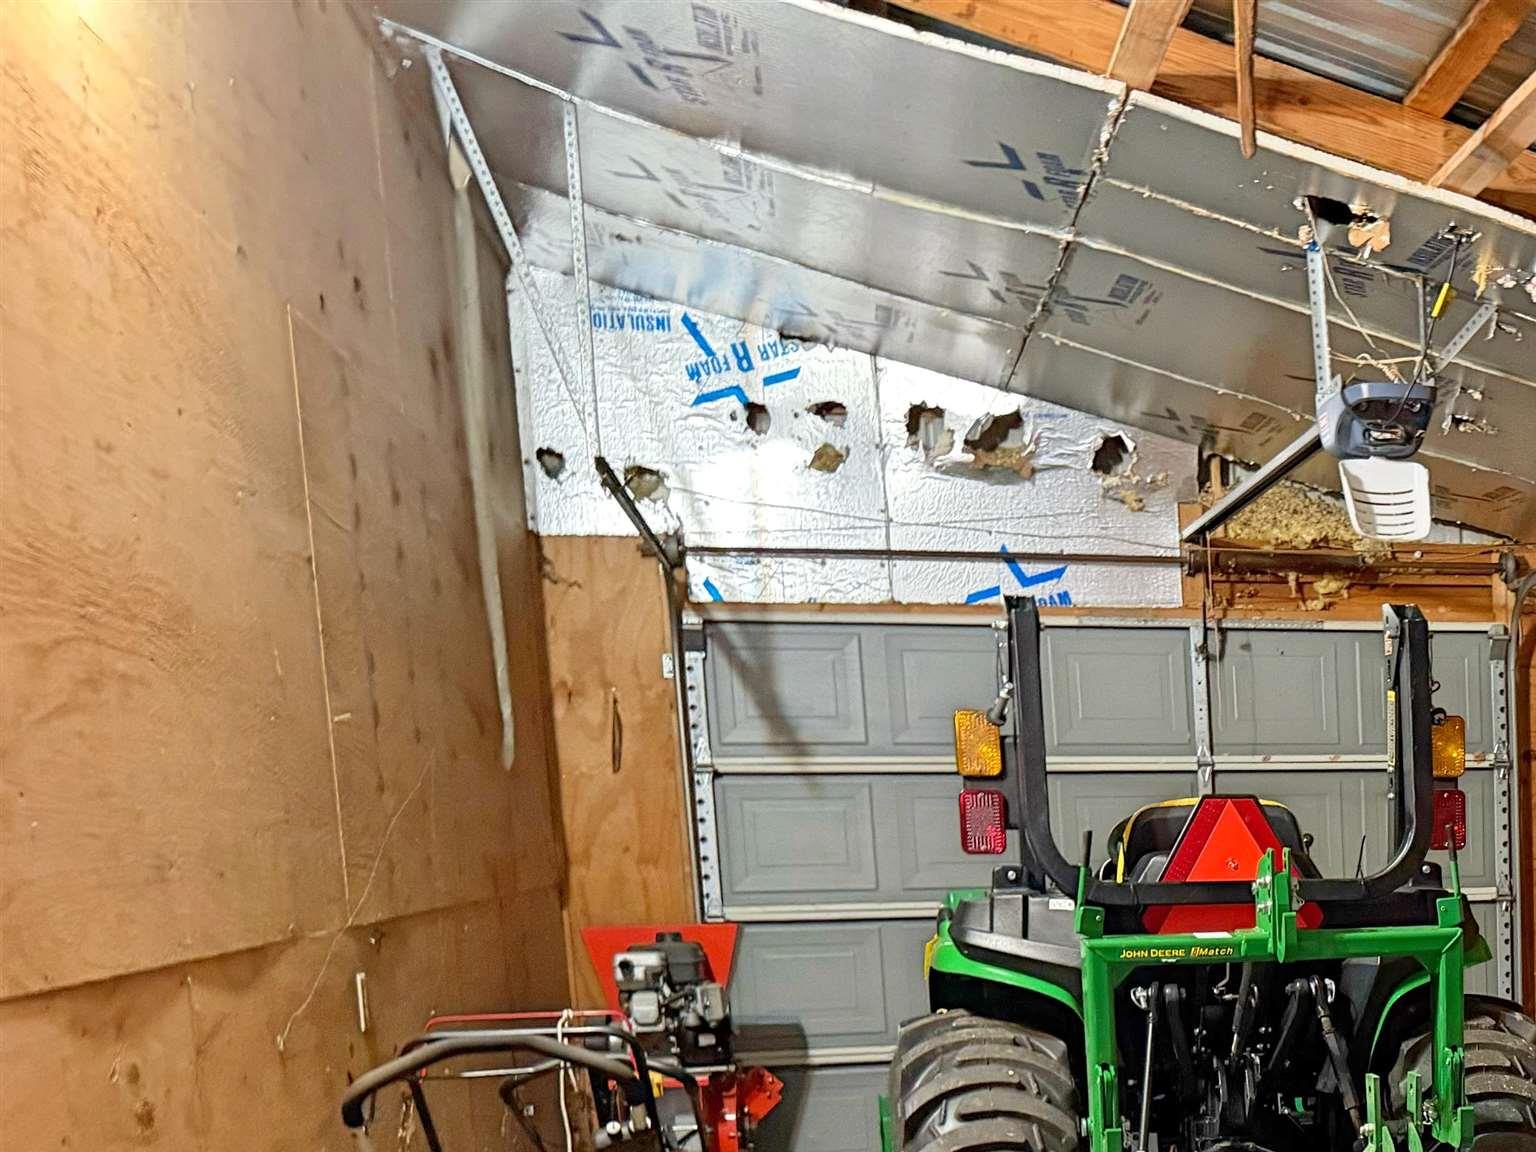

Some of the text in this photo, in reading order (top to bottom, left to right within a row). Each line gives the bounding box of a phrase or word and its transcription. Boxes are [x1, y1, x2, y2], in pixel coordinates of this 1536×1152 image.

[684, 355, 732, 384] FOAM
[729, 340, 756, 374] R
[1119, 949, 1148, 959] JOHN
[1150, 948, 1186, 958] DEERE
